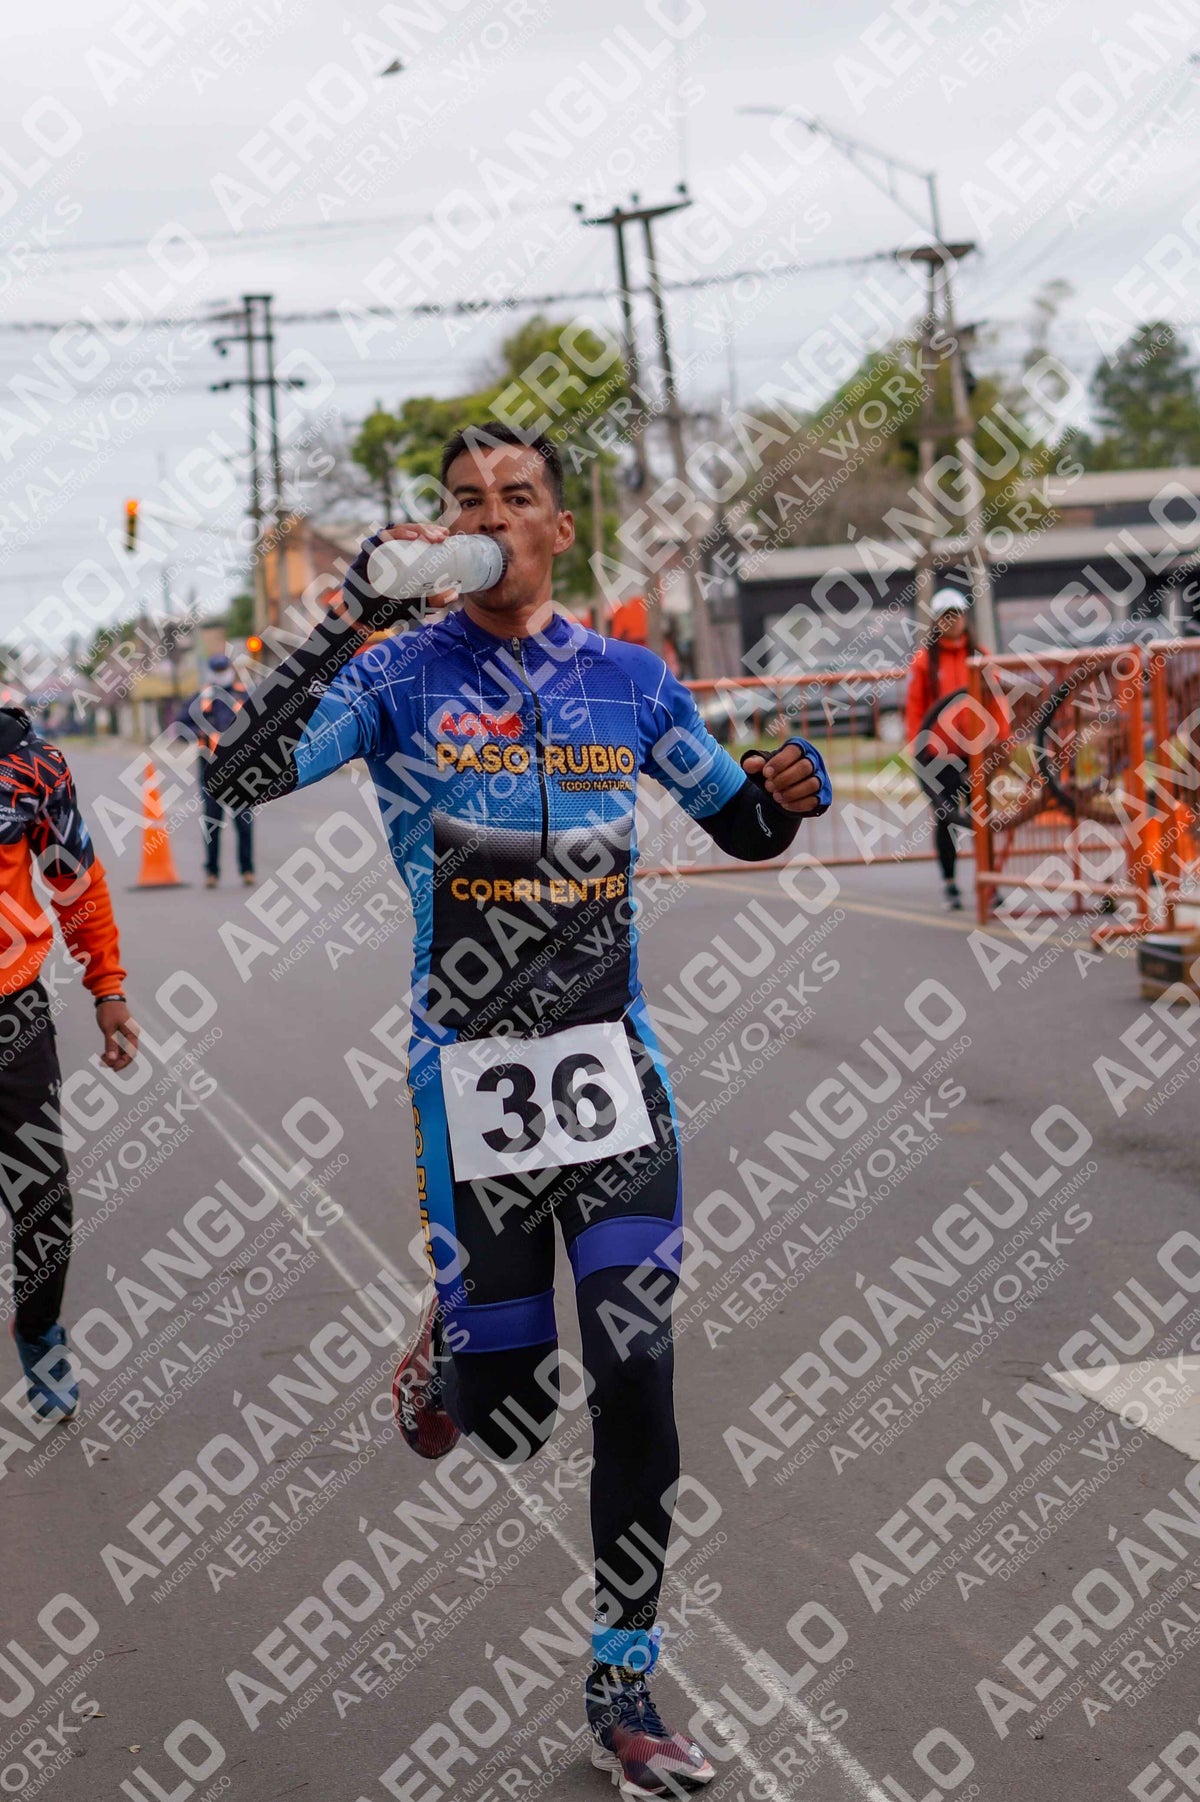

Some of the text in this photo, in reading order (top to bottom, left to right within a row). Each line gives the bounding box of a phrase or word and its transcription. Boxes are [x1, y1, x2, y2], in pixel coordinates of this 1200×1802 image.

[436, 743, 635, 775] PASO RUBIO
[559, 780, 591, 792] TODO
[476, 1053, 617, 1153] 36
